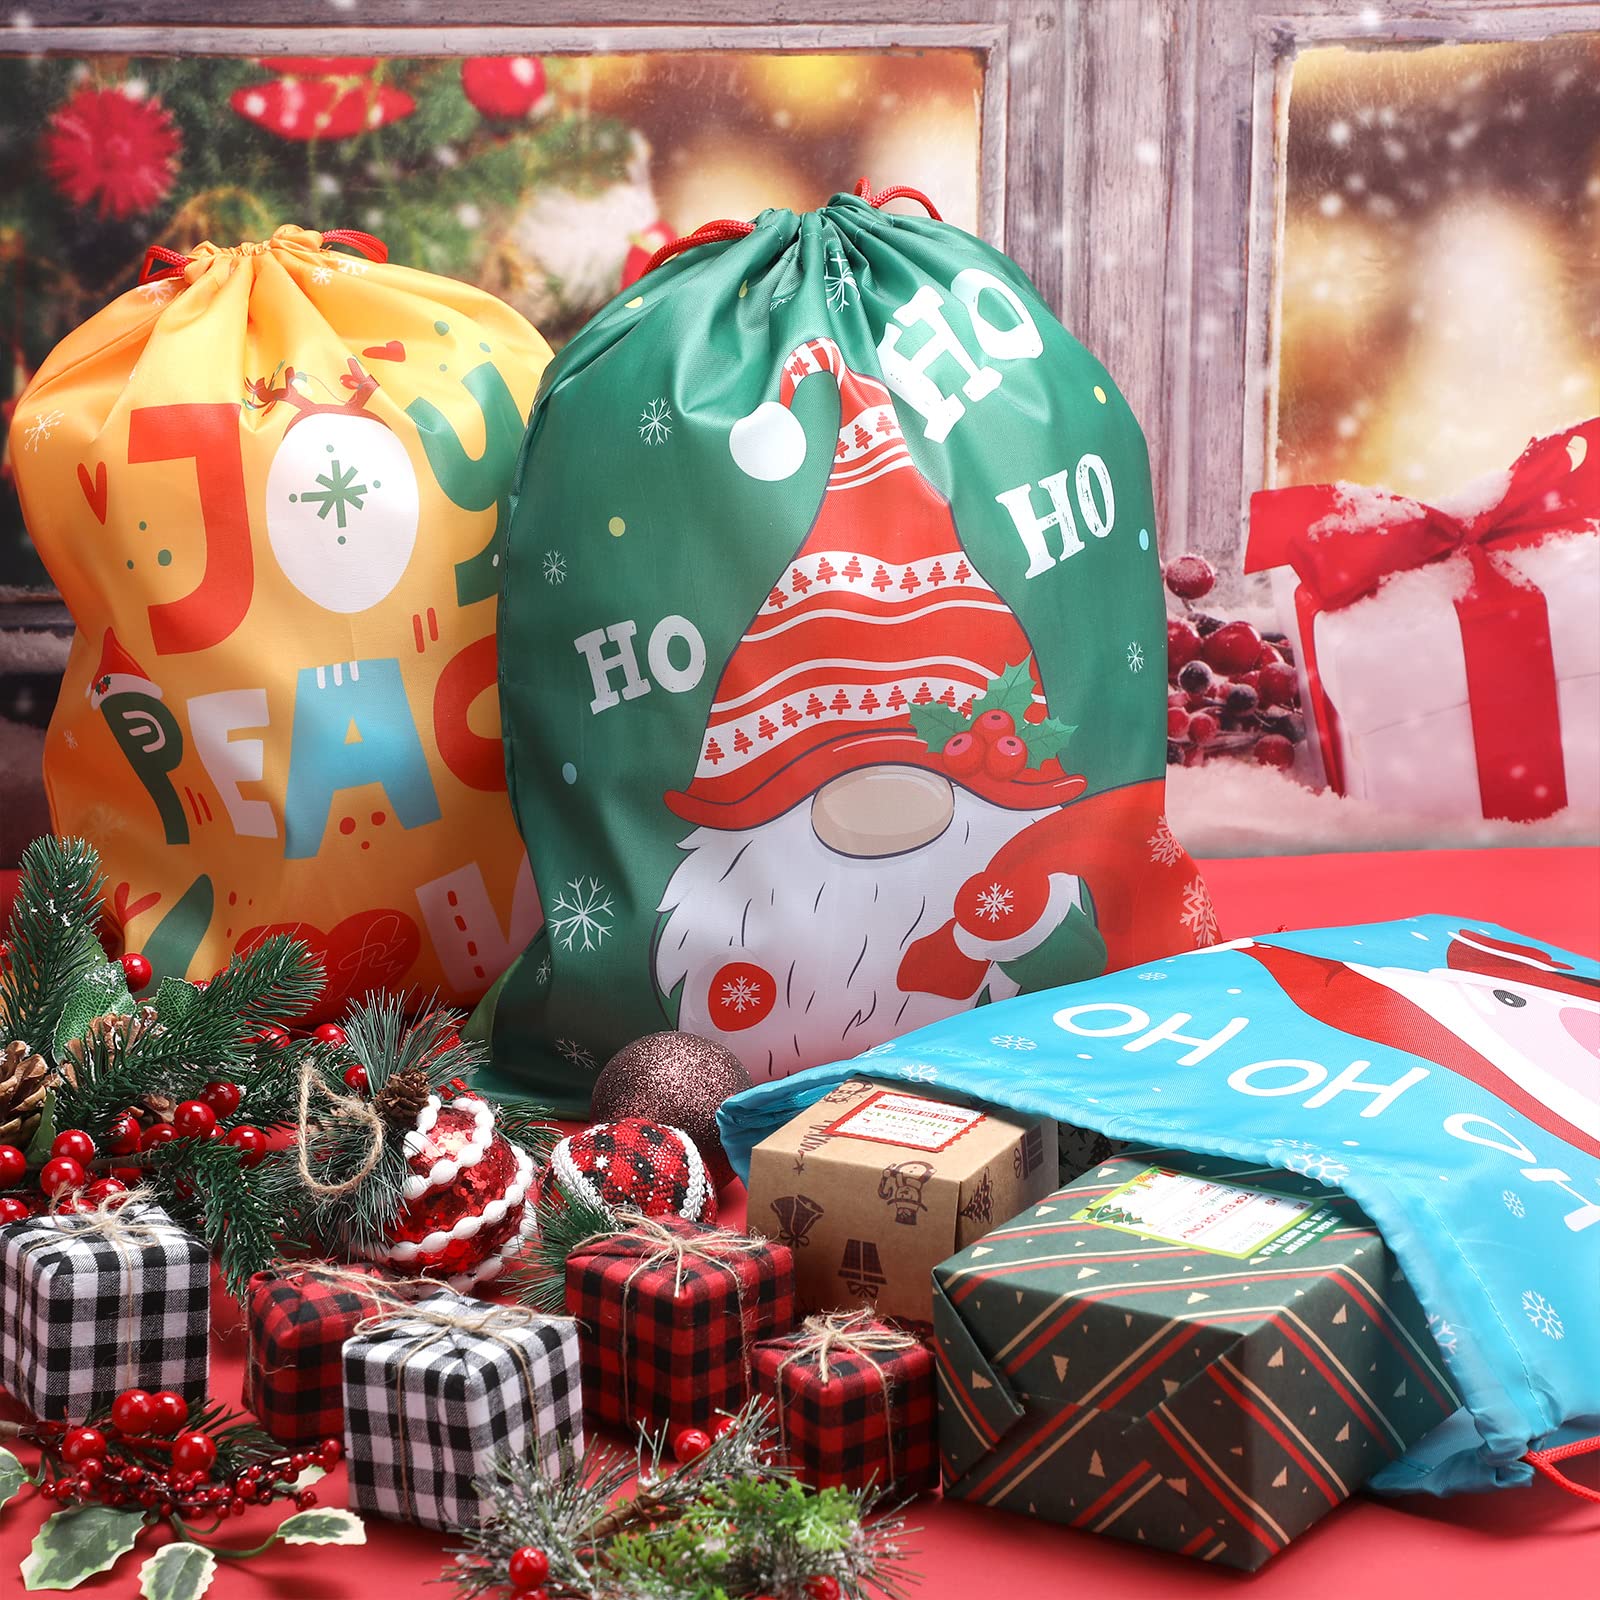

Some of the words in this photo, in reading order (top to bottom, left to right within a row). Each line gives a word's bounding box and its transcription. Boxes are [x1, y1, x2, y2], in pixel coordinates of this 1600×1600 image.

[876, 268, 1044, 444] HO
[127, 362, 529, 655] JOY
[994, 453, 1116, 580] HO
[573, 614, 707, 715] HO
[102, 633, 510, 860] PEAC
[1052, 1002, 1249, 1067] HO
[1226, 1058, 1431, 1118] HO
